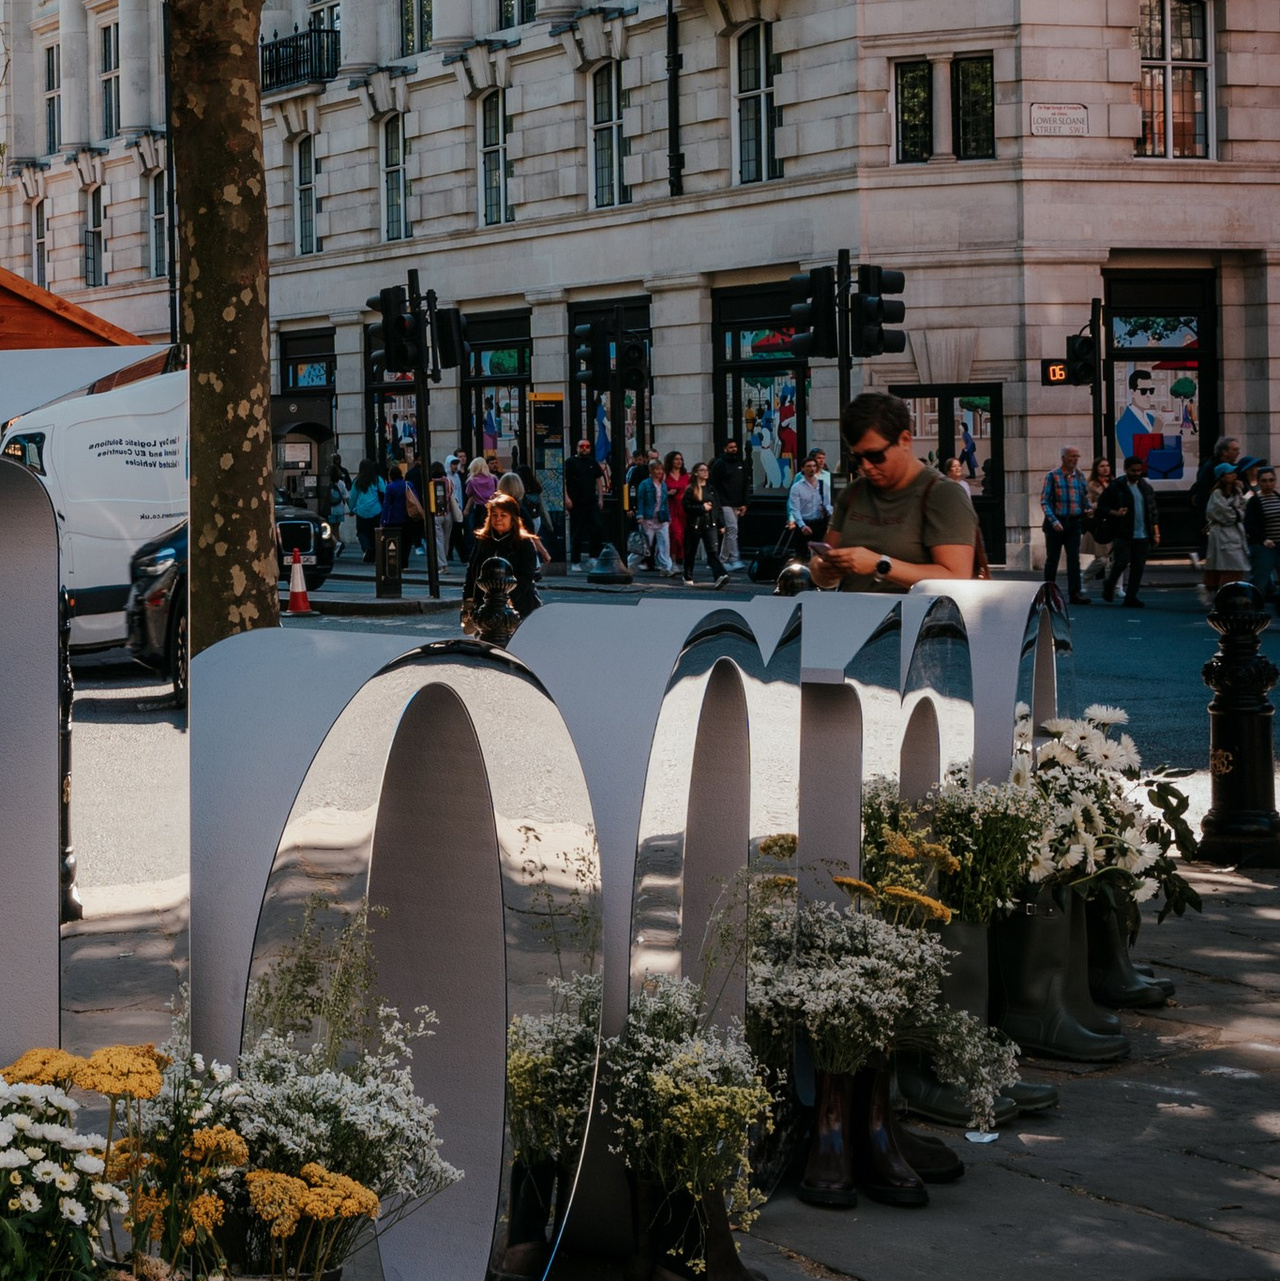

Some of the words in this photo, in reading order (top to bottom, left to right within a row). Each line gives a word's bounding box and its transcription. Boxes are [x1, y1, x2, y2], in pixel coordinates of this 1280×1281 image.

[1033, 117, 1057, 125] LOWER
[1058, 117, 1086, 125] SLOANE
[1035, 126, 1062, 134] STREET
[1049, 364, 1066, 381] 06
